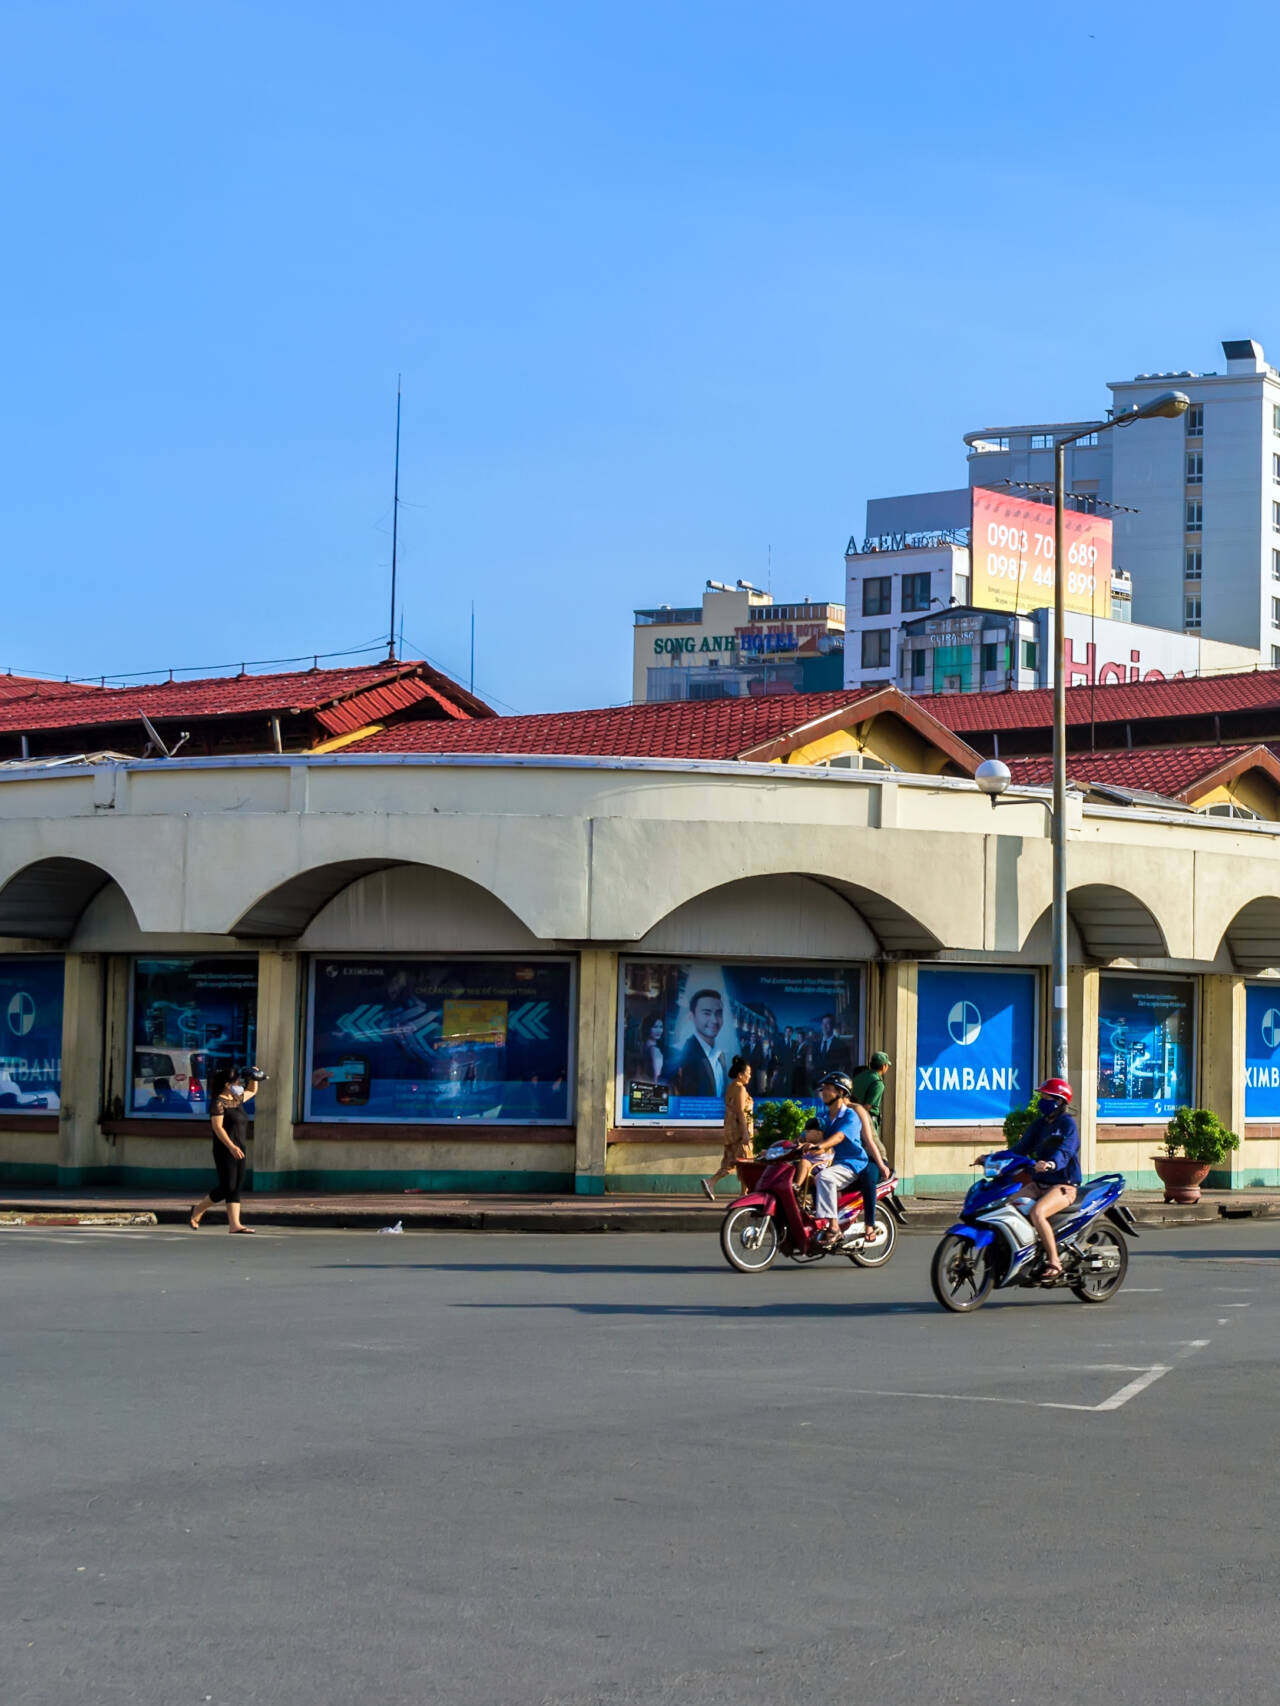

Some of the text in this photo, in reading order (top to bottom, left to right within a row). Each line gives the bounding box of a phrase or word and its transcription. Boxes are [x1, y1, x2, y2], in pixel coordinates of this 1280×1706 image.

[987, 522, 1028, 553] 0903
[1067, 541, 1098, 568] 689
[987, 553, 1027, 583] 0987
[1067, 573, 1097, 597] 899
[654, 632, 798, 654] SONG ANH HOTEL
[1064, 638, 1185, 688] Hai
[918, 1067, 1021, 1091] XIMBANK
